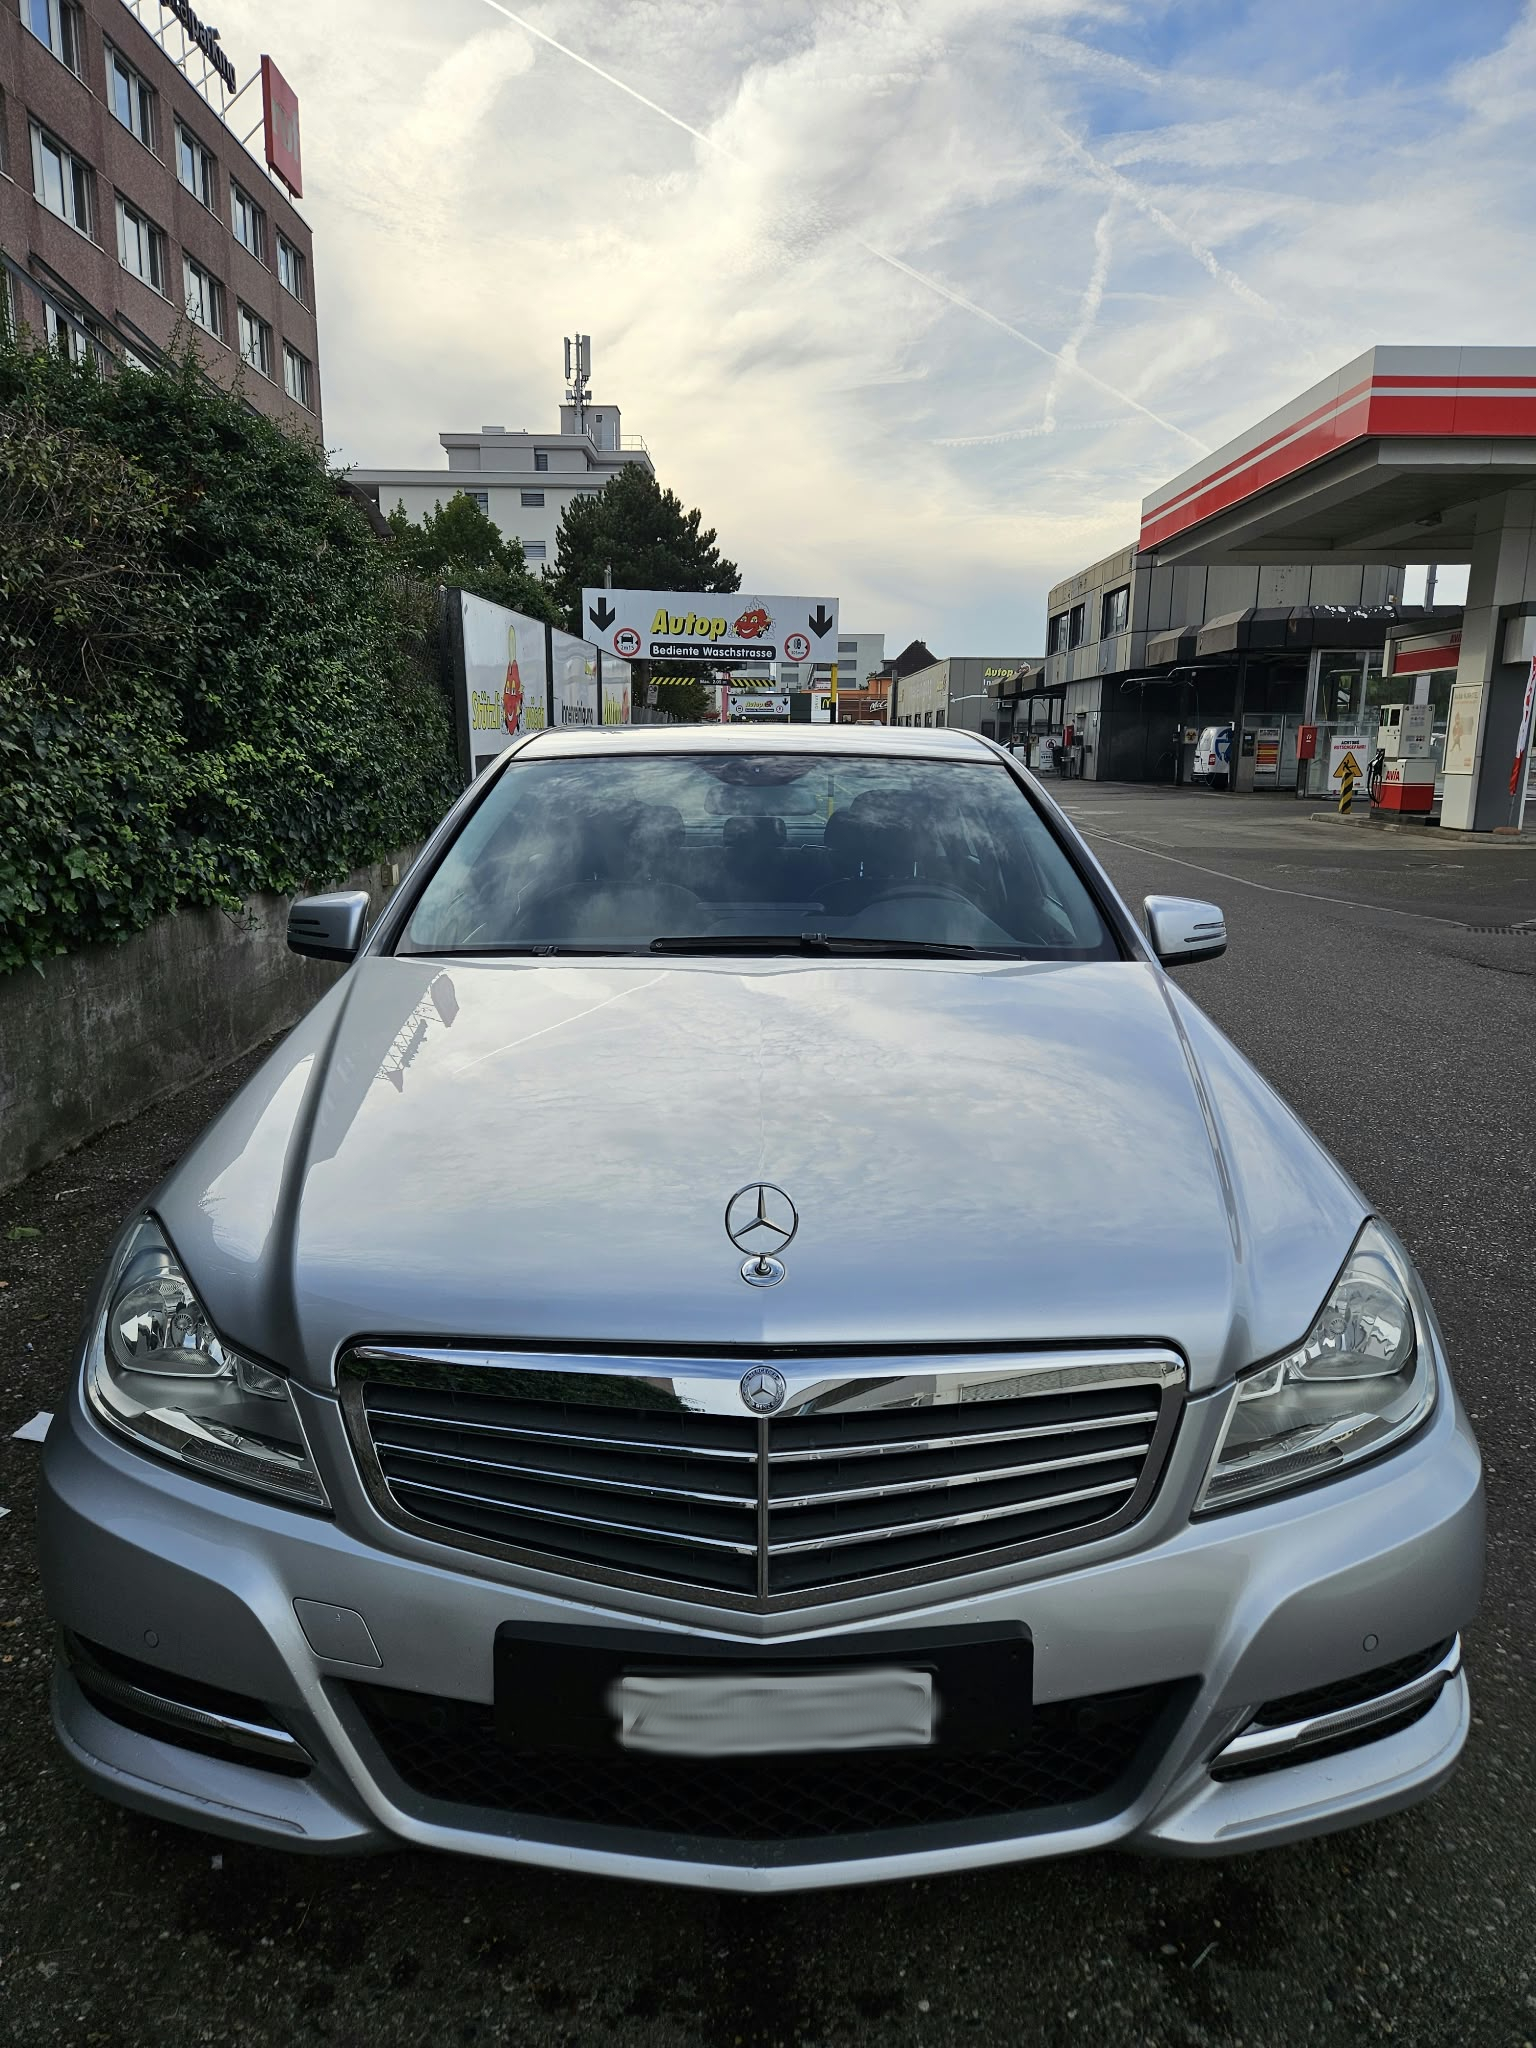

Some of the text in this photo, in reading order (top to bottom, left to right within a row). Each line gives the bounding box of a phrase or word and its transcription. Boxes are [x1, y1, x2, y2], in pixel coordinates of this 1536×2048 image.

[650, 608, 727, 641] Autop
[652, 645, 773, 659] Bediente Waschstrasse
[984, 667, 1014, 678] Autop
[471, 690, 501, 730] Stützli
[1385, 770, 1400, 781] AVIA
